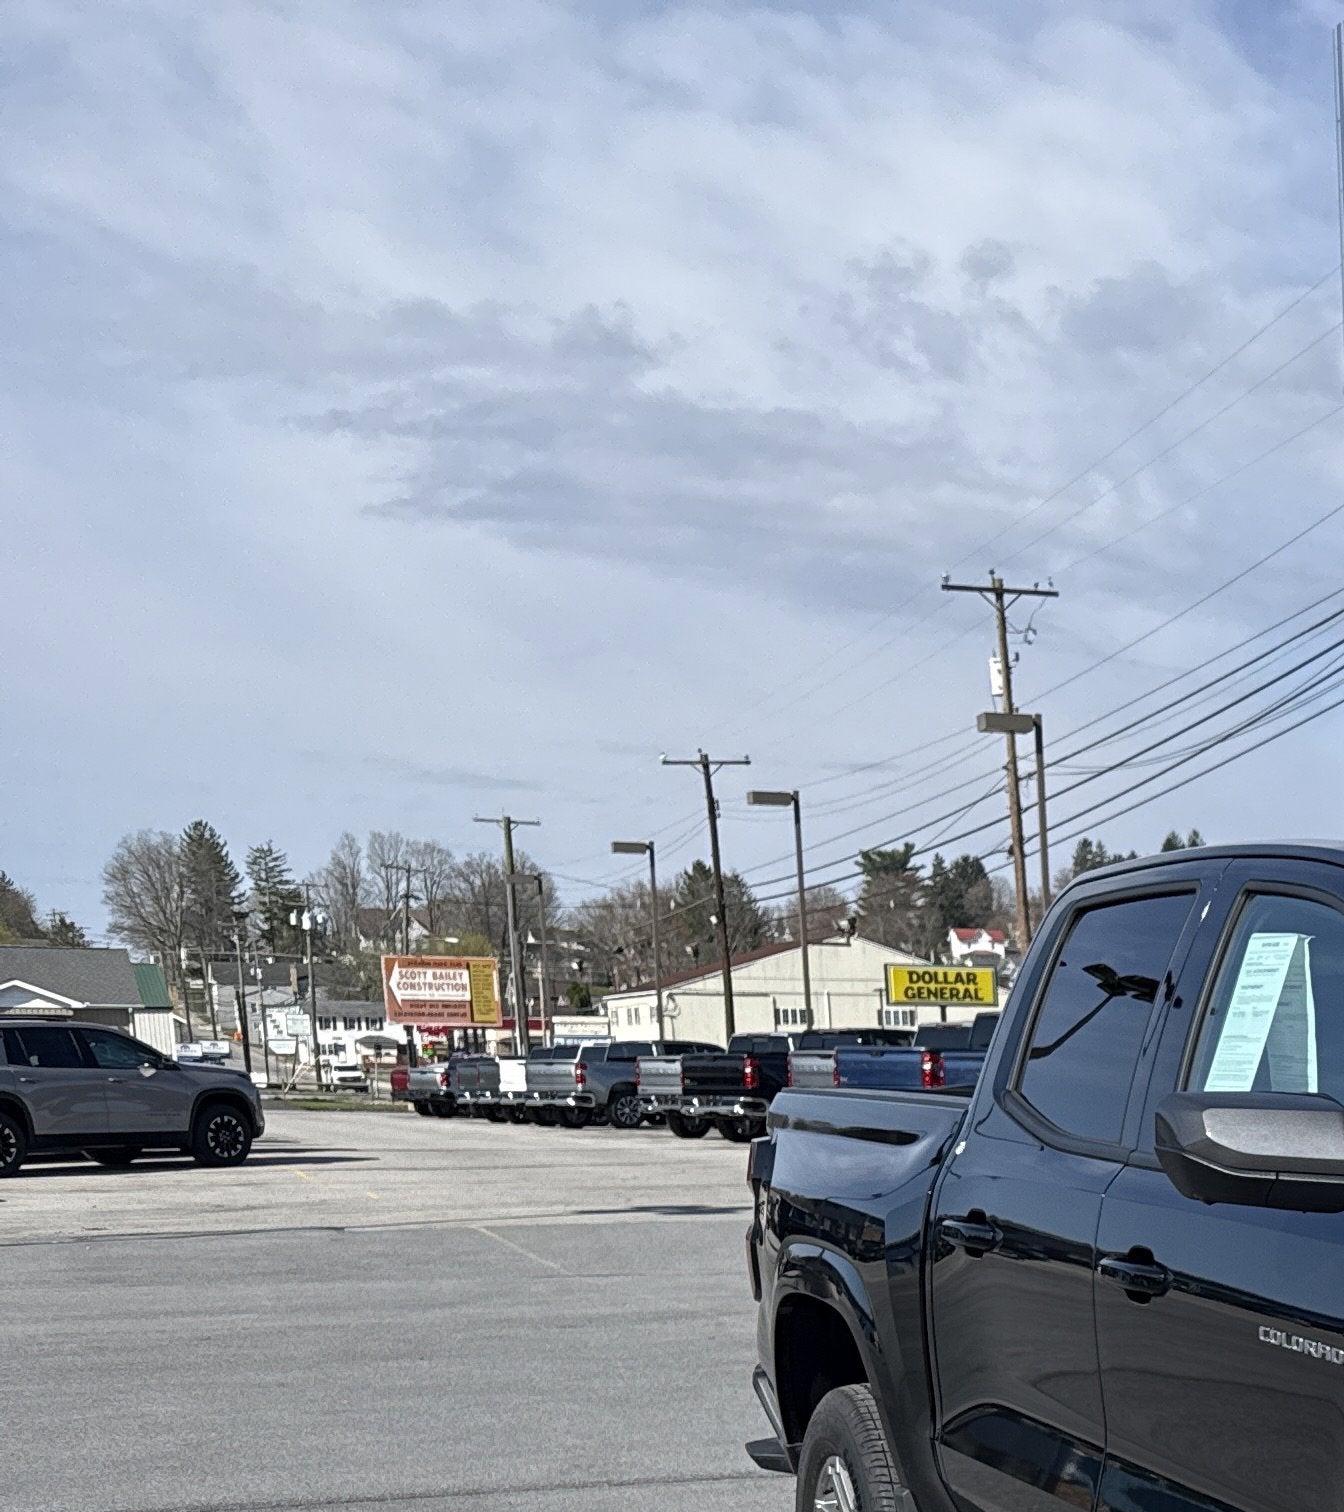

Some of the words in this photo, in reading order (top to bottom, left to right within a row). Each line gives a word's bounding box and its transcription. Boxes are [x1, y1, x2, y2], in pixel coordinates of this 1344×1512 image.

[398, 970, 427, 980] SCOTT
[432, 971, 464, 981] BAILEY
[907, 970, 979, 985] DOLLAR
[396, 982, 468, 992] CONSTRUCTION
[904, 986, 984, 1001] GENERAL
